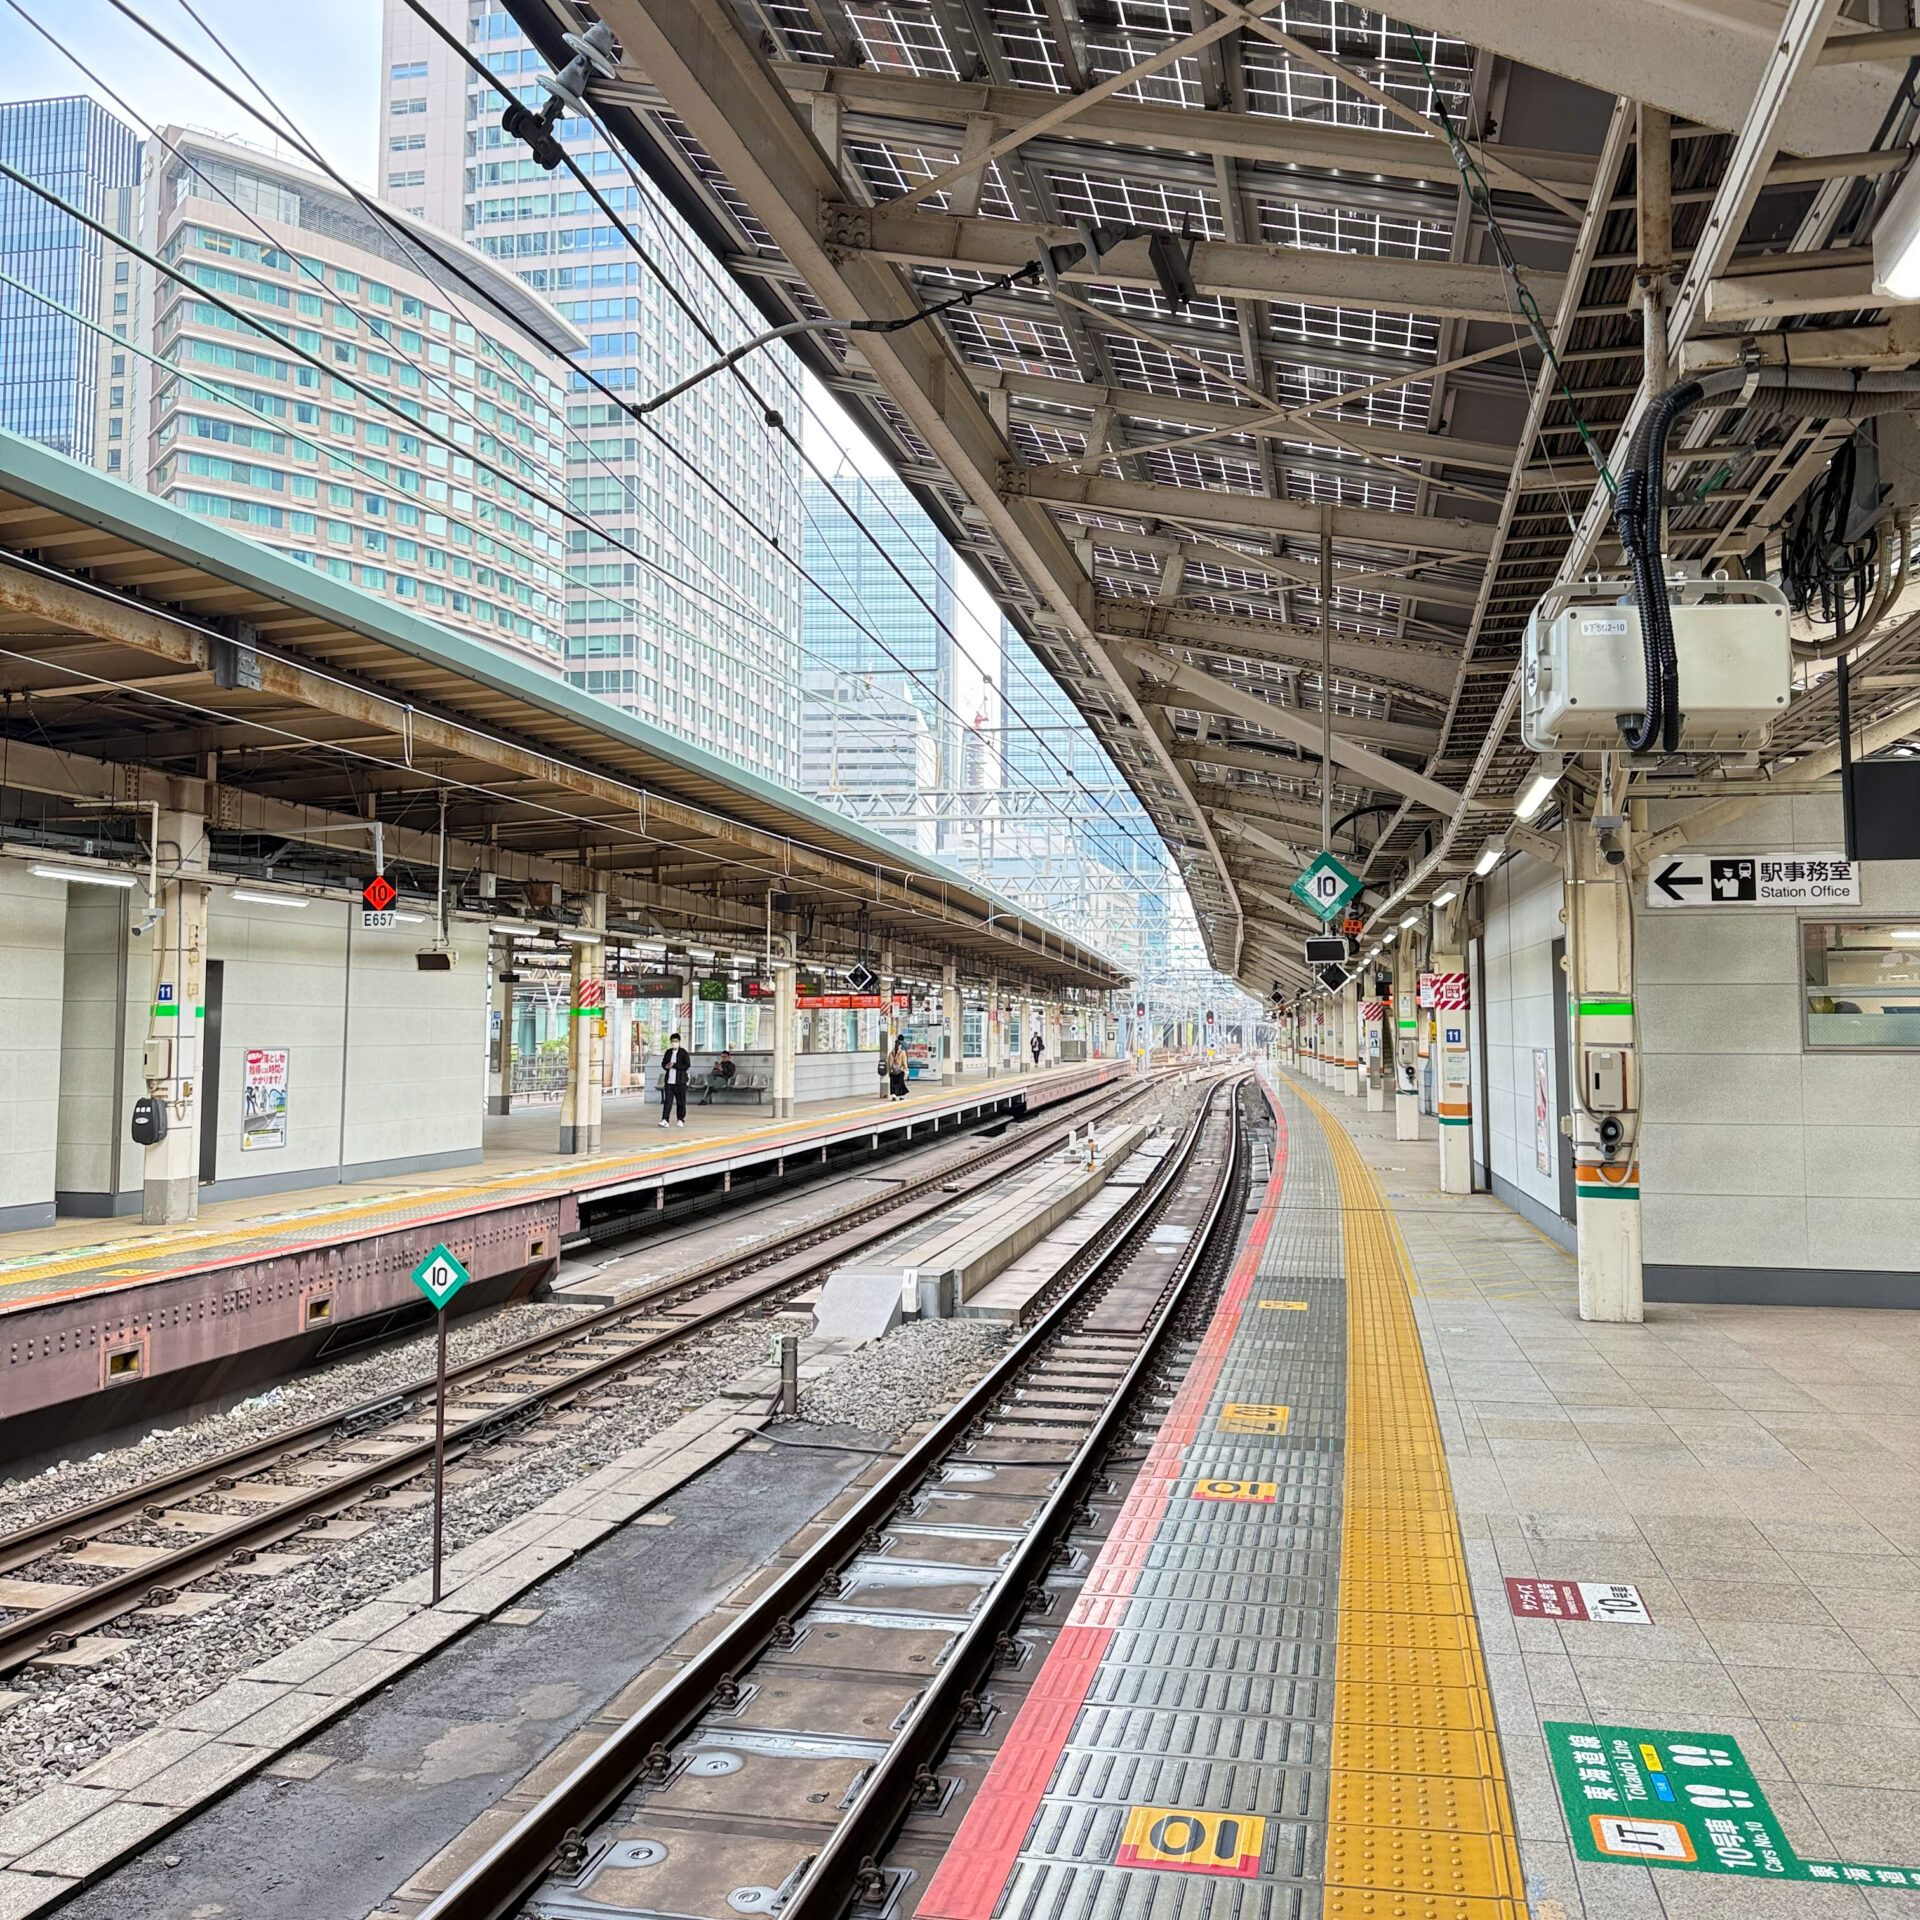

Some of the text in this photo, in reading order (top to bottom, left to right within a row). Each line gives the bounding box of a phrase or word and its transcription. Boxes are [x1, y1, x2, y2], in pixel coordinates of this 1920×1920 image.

[1760, 861, 1852, 882] 駅事務室
[371, 884, 388, 902] 10
[1317, 876, 1336, 898] 10
[1761, 885, 1851, 898] Station Office
[364, 913, 394, 927] E657
[1377, 972, 1384, 981] 9
[160, 986, 172, 998] 11
[900, 997, 908, 1007] 8
[1447, 1031, 1459, 1040] 11
[432, 1267, 447, 1286] 10
[1516, 1584, 1540, 1611] サンライズ
[1598, 1585, 1641, 1615] 10号車
[1568, 1734, 1619, 1802] 東海道線
[1612, 1739, 1649, 1801] Tōkaidō Line
[1615, 1824, 1665, 1851] JT
[1705, 1817, 1758, 1868] 10号車
[1745, 1821, 1785, 1873] Cars No.10
